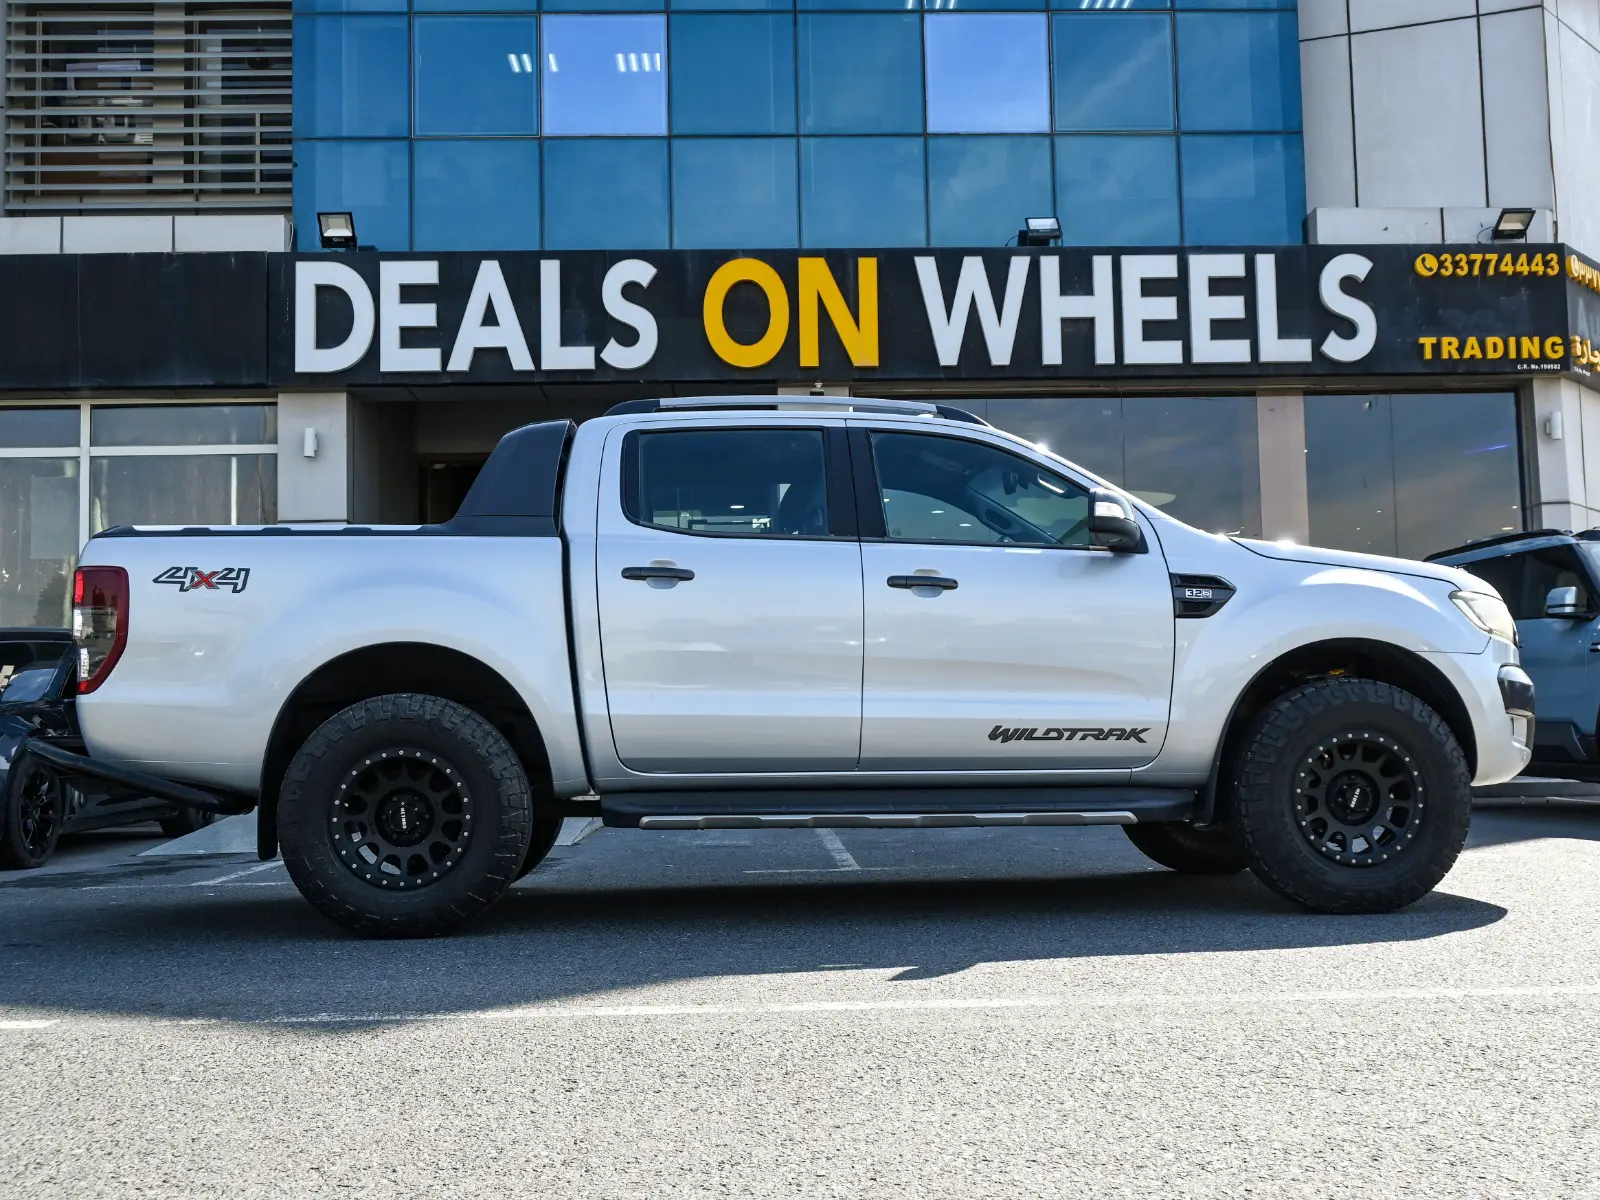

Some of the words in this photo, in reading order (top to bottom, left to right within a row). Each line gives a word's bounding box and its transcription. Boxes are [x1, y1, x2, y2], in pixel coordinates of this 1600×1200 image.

[1439, 253, 1560, 276] 33774443
[295, 257, 658, 373] DEALS
[703, 257, 879, 369] ON
[914, 253, 1378, 367] WHEELS
[1418, 336, 1564, 360] TRADING
[988, 725, 1152, 743] WILDTRAK
